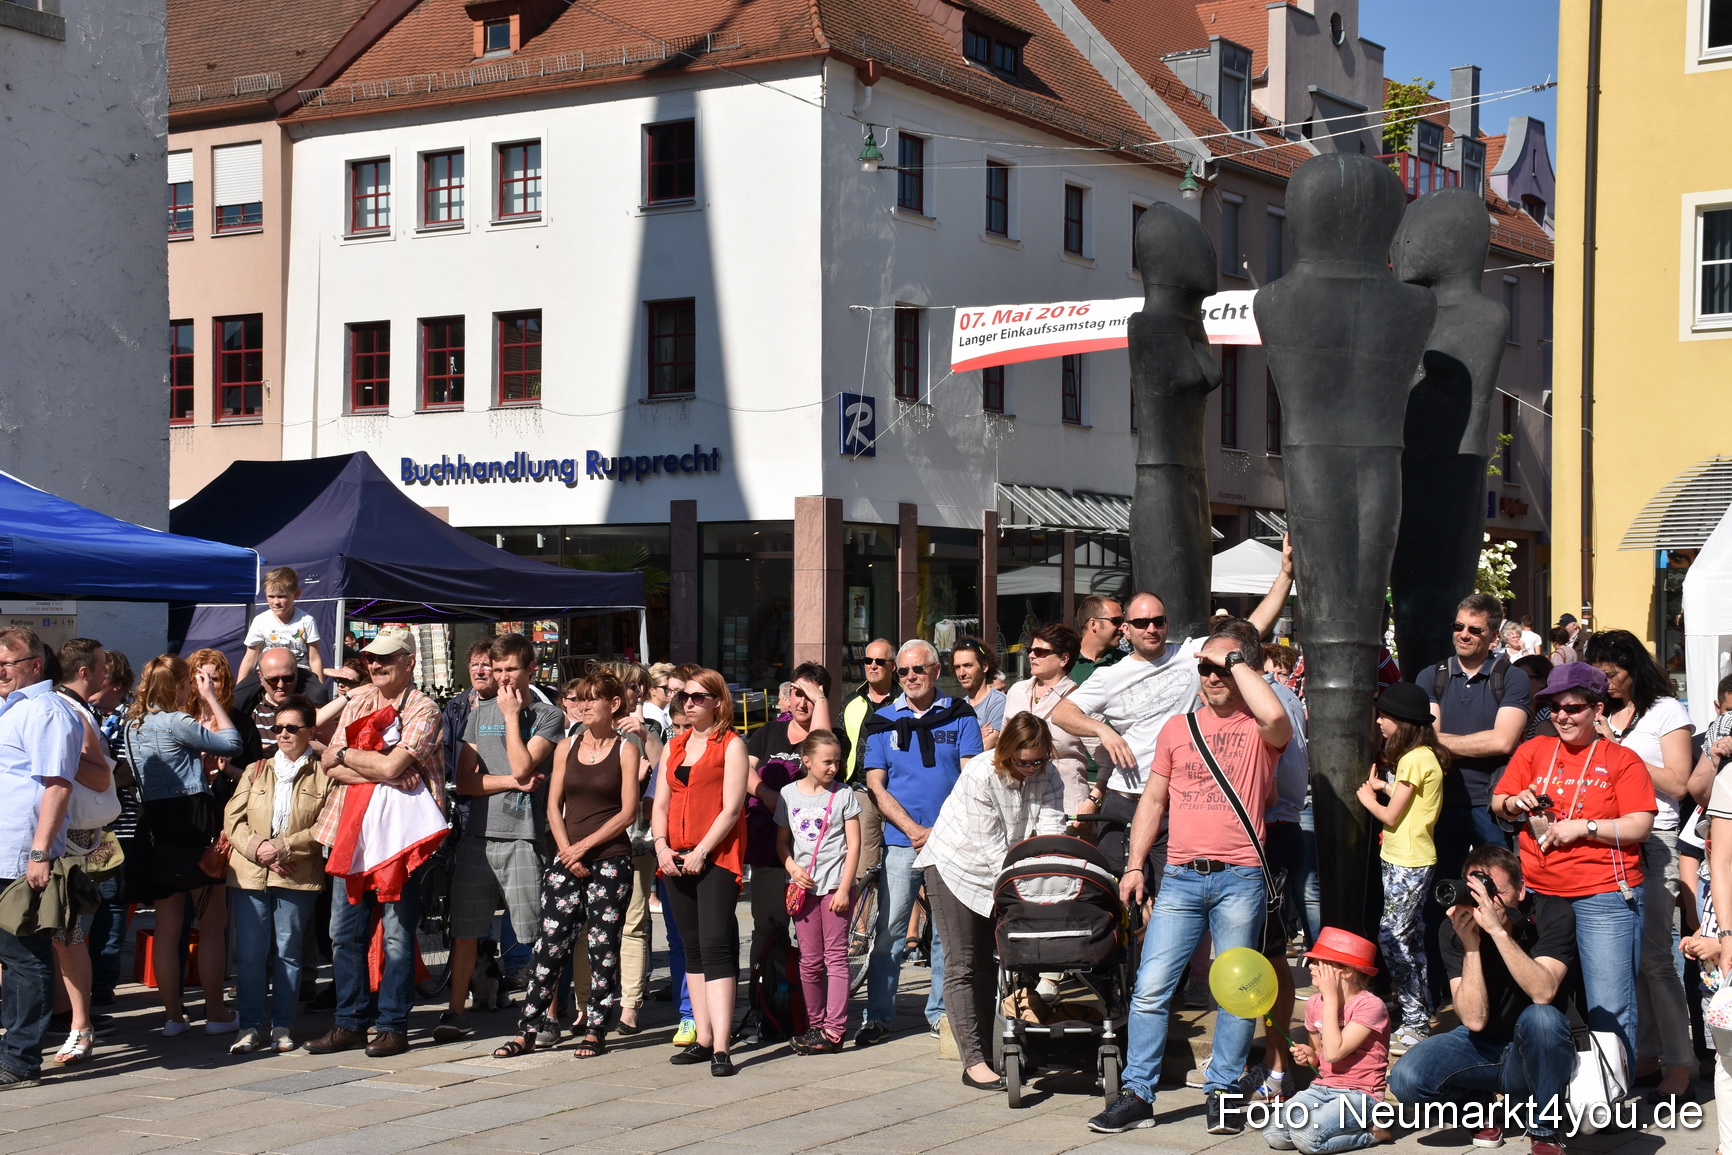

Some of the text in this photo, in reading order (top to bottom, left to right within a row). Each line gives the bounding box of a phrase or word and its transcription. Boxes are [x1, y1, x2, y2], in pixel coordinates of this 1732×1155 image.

[959, 304, 1091, 331] 07. Mai 2016
[959, 331, 998, 347] Langer
[1001, 318, 1106, 340] Einkaufssamstag
[401, 444, 720, 486] Buchhandlung Rupprecht
[1188, 732, 1247, 753] IFINITE
[1184, 761, 1209, 772] NEX
[1187, 771, 1203, 780] BIG
